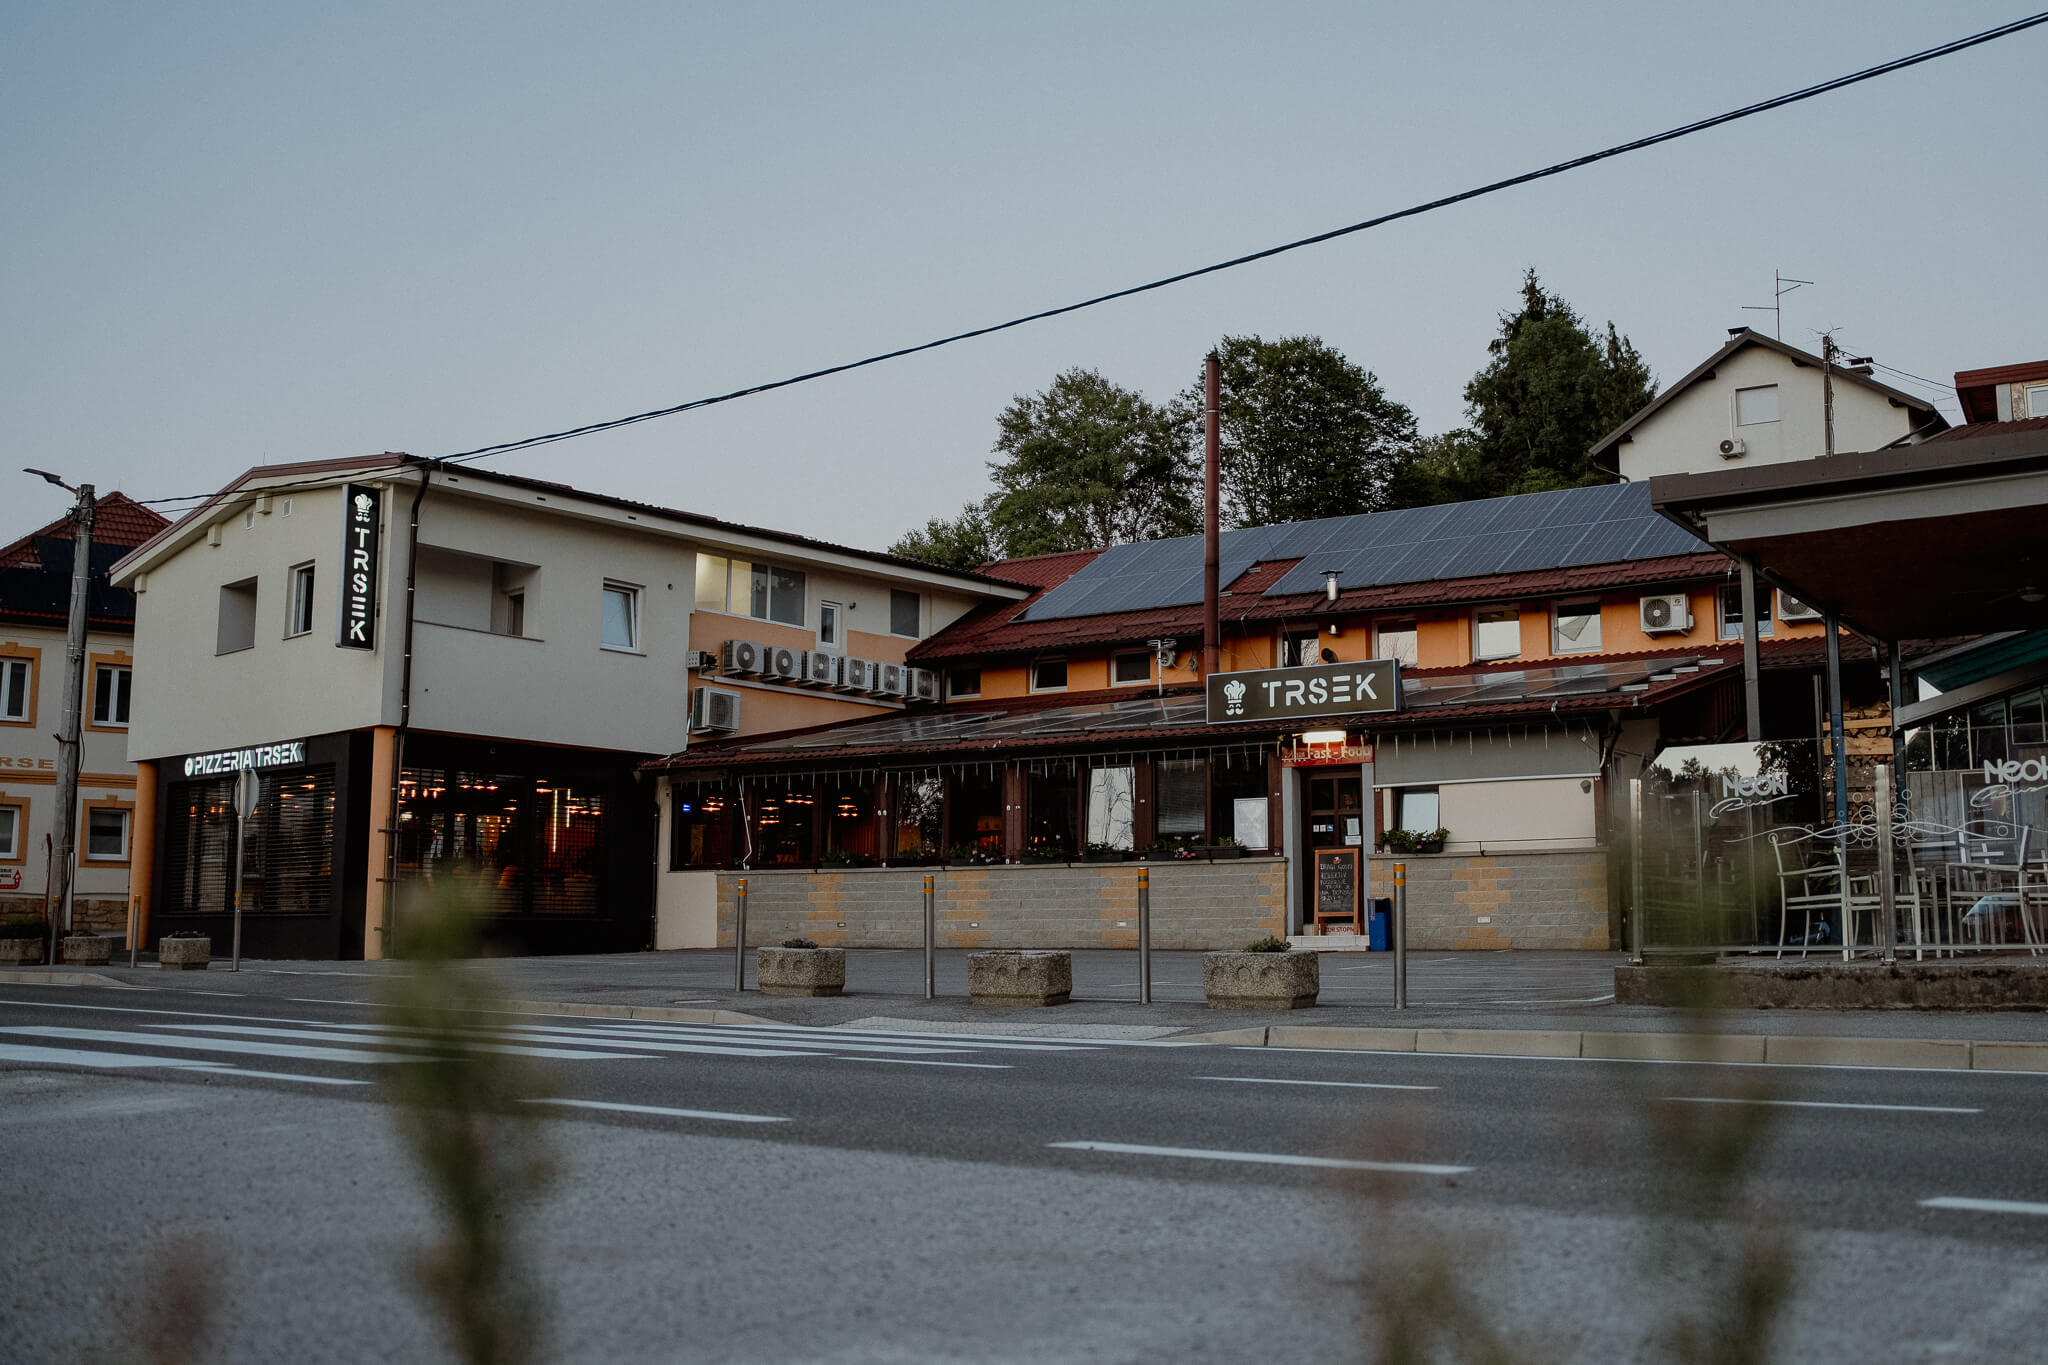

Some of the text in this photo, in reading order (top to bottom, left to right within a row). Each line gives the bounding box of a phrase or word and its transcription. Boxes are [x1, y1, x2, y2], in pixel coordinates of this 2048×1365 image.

[350, 527, 370, 641] TRSEK
[1262, 673, 1377, 708] TRSEK
[0, 757, 54, 769] RSE
[194, 742, 303, 775] PIZZERIA TRSEK
